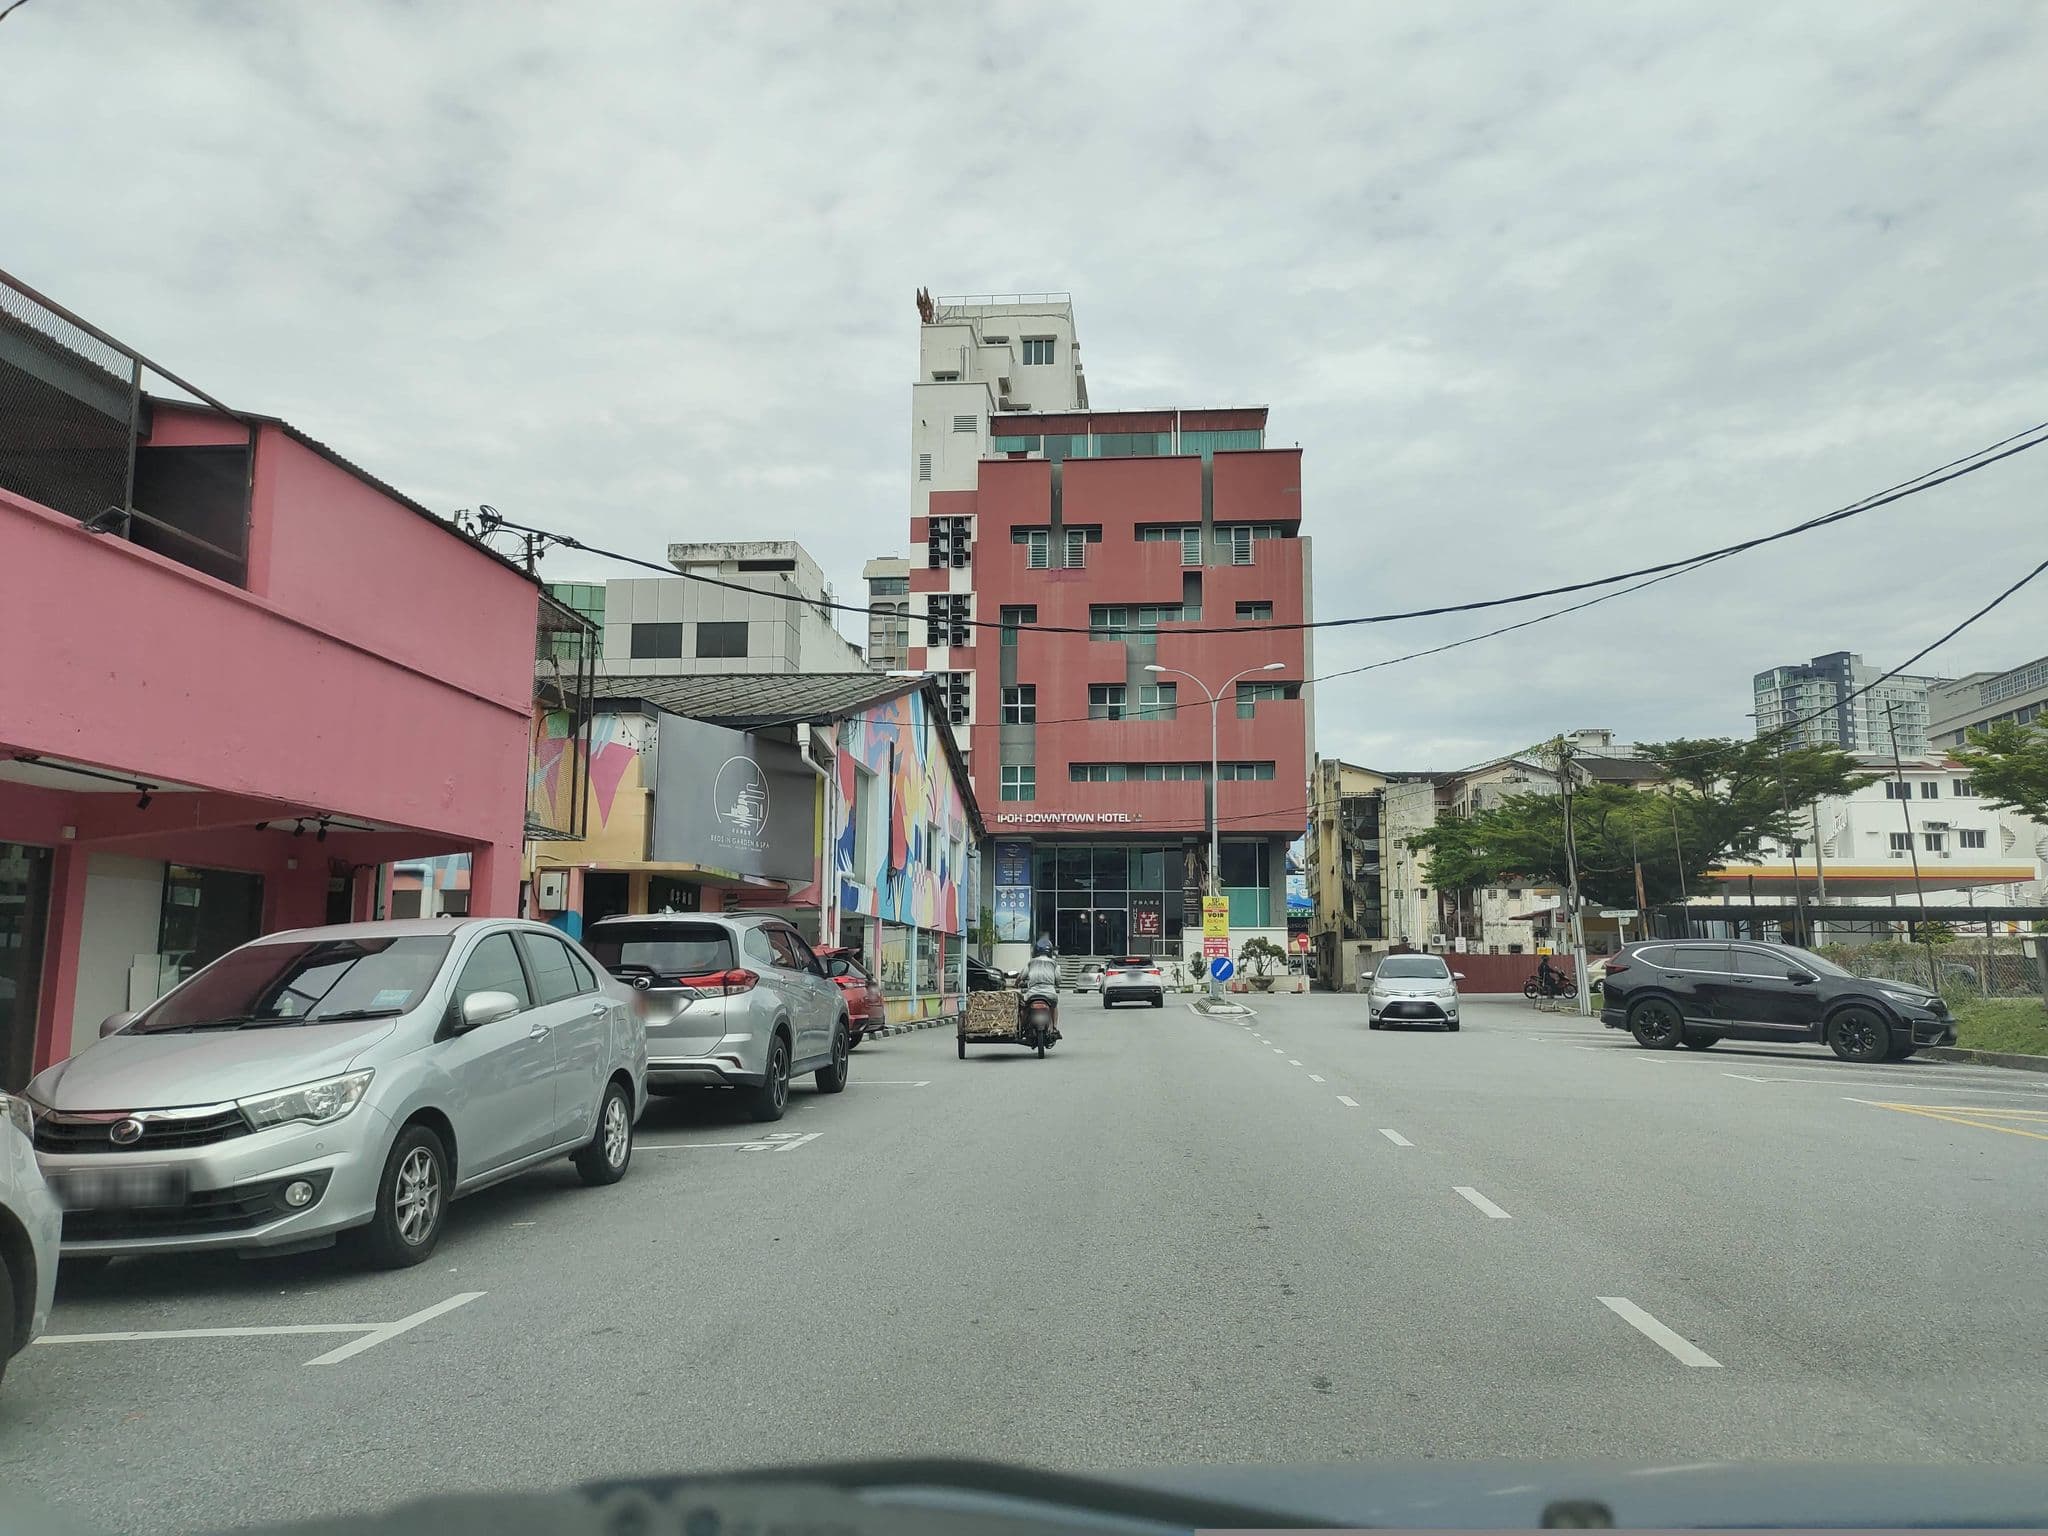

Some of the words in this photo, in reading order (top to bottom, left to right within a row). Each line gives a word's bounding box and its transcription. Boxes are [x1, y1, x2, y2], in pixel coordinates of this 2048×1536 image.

[997, 812, 1022, 823] IPOH
[1025, 812, 1094, 823] DOWNTOWN
[1097, 812, 1131, 823] HOTEL
